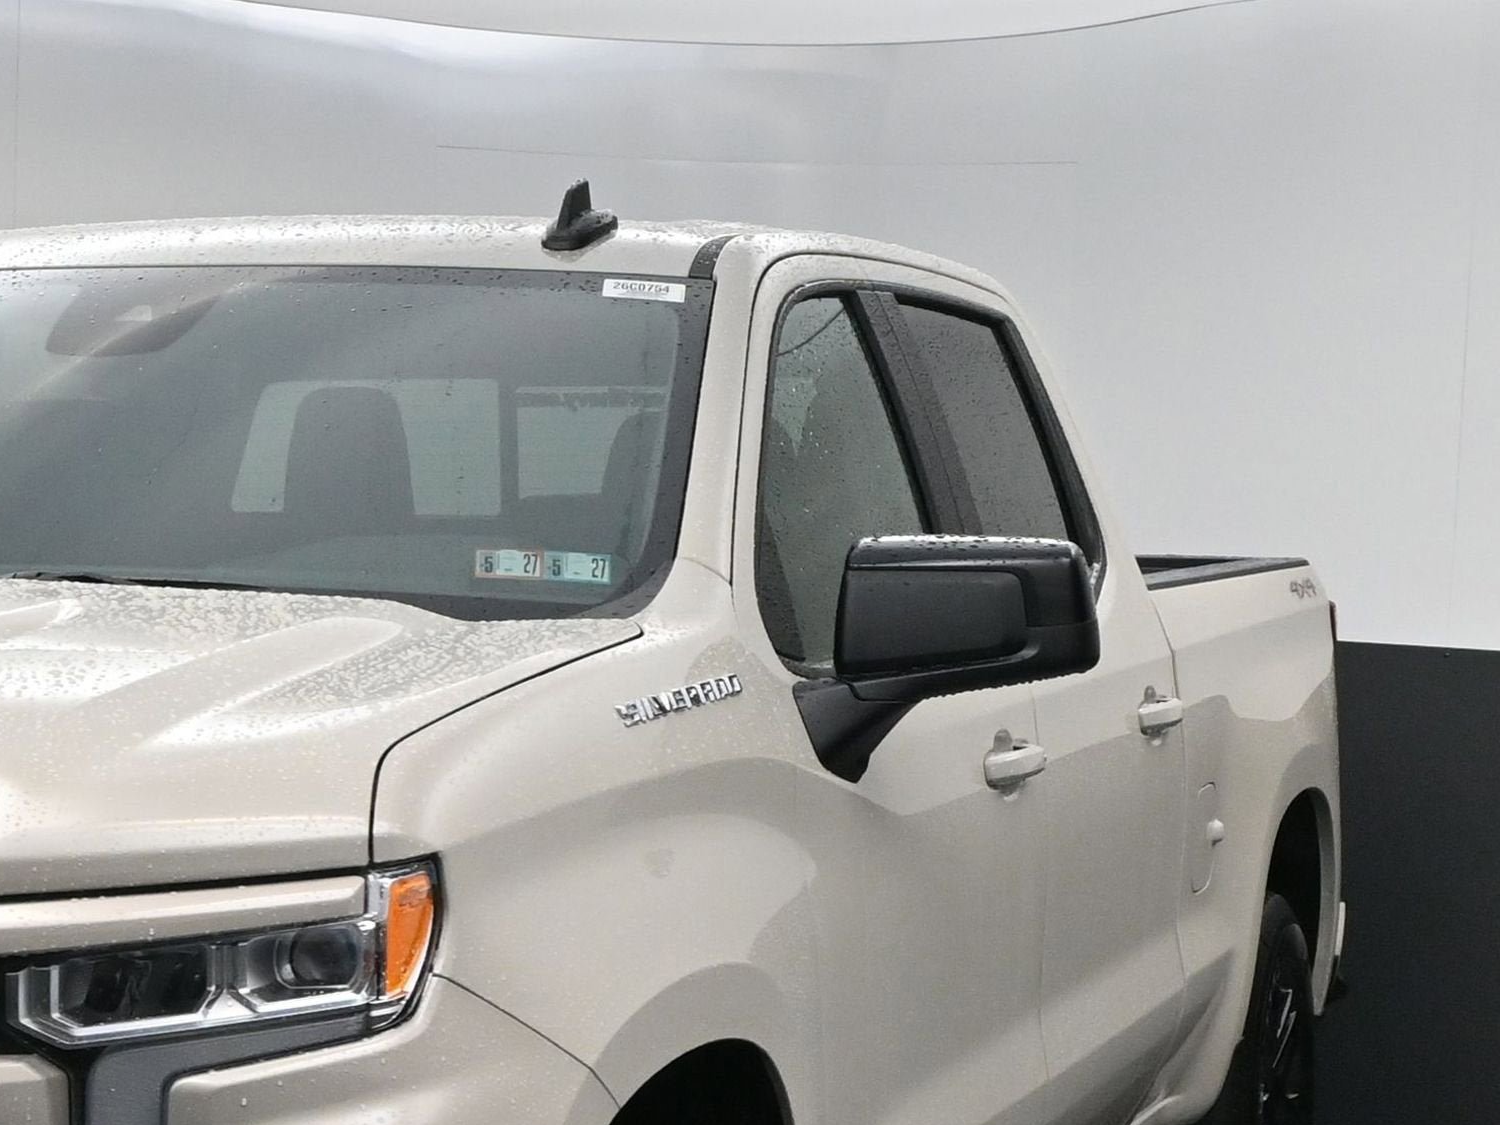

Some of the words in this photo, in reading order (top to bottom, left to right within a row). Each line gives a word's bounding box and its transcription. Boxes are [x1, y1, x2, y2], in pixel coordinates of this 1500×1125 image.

[523, 553, 538, 575] 27
[591, 558, 607, 580] 27
[614, 674, 743, 728] SILVERADO
